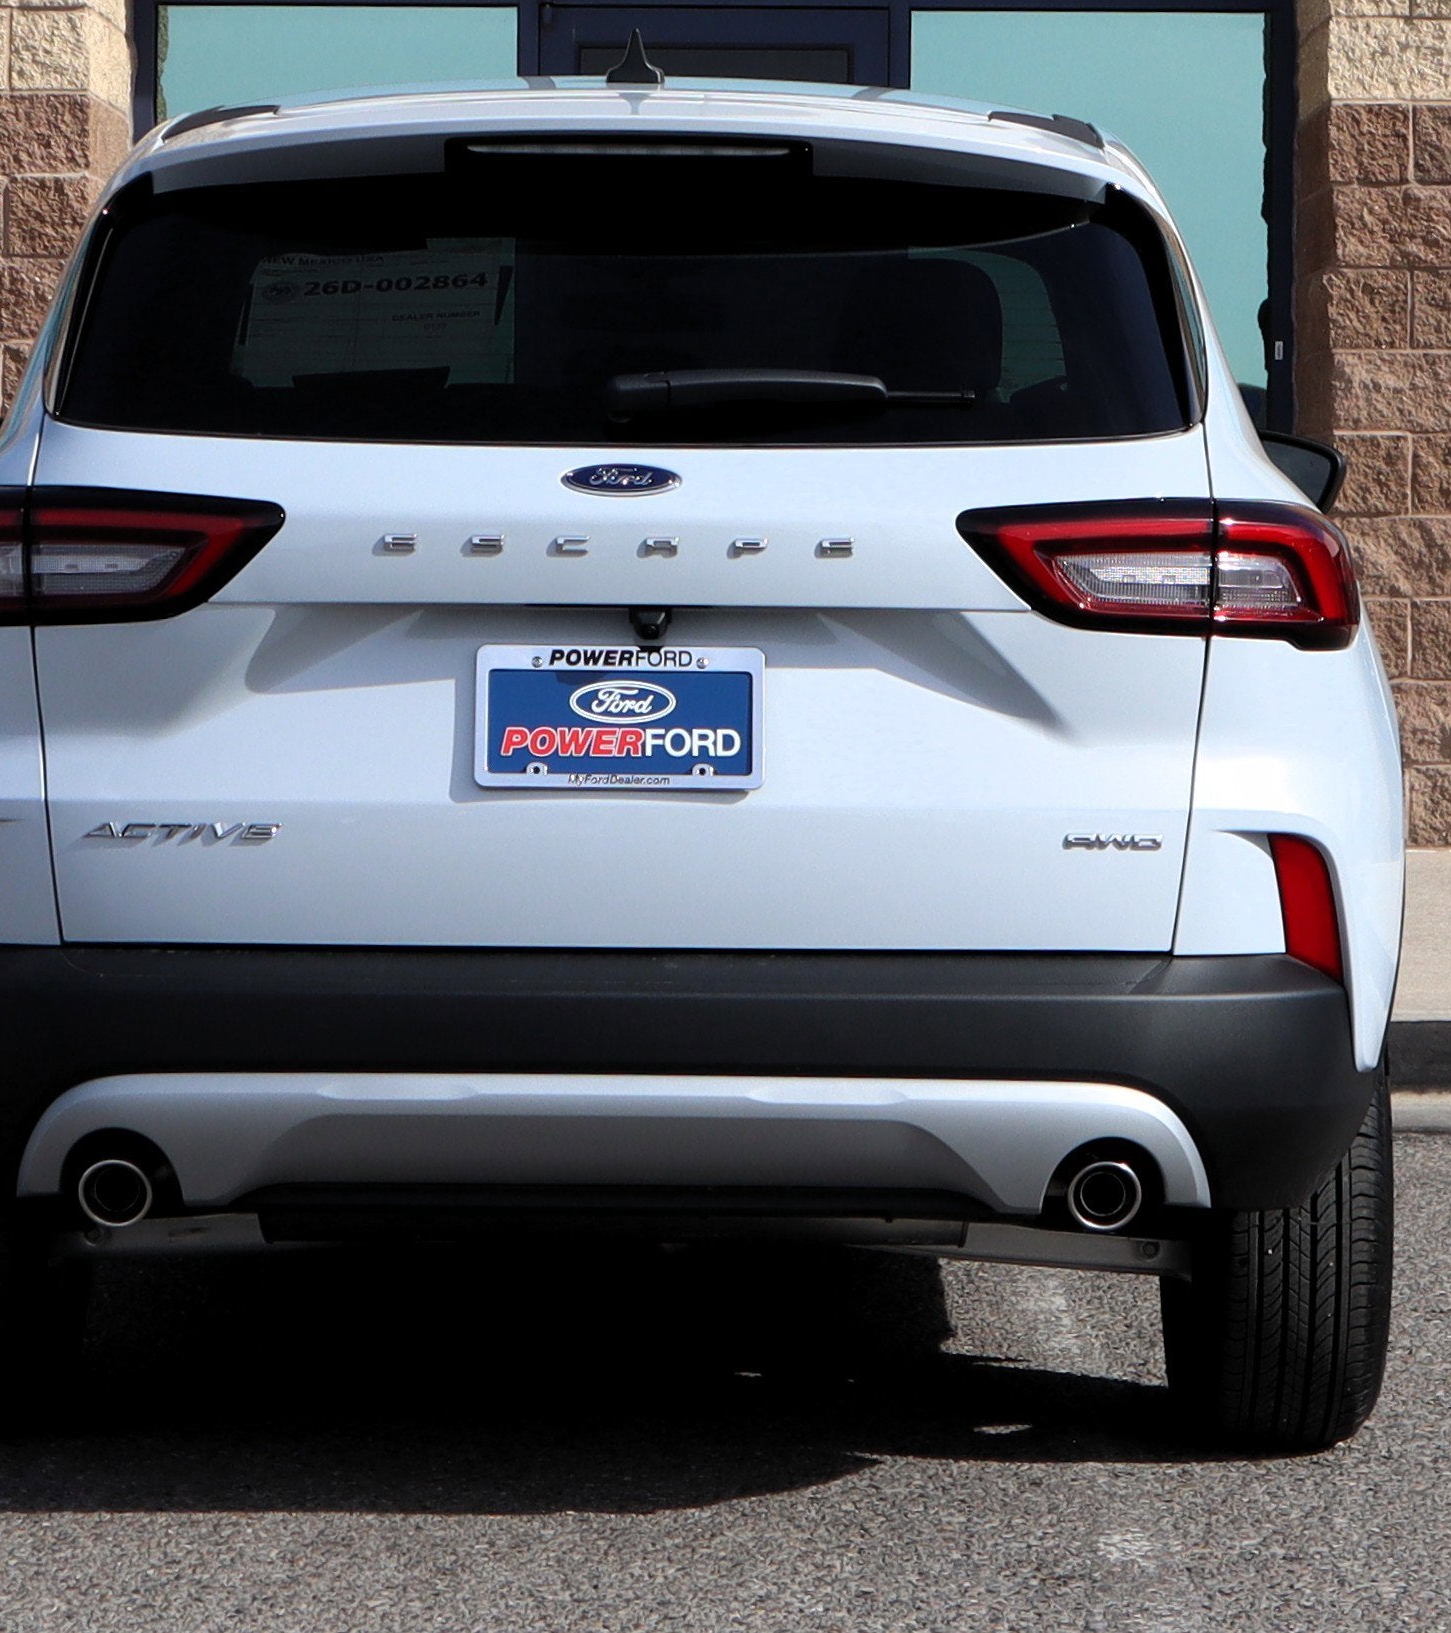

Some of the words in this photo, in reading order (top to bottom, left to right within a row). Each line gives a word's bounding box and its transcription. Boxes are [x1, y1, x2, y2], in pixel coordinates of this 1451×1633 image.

[303, 271, 488, 297] 26D-002864
[391, 312, 434, 322] DEALER
[436, 310, 480, 319] NUMBER
[588, 466, 653, 487] Ford
[380, 532, 856, 558] ESCAPE
[548, 648, 693, 668] POWERFORD
[592, 687, 653, 715] Ford
[500, 725, 742, 758] POWERFORD
[83, 821, 282, 841] ACTIVE
[1062, 832, 1163, 852] AWD
